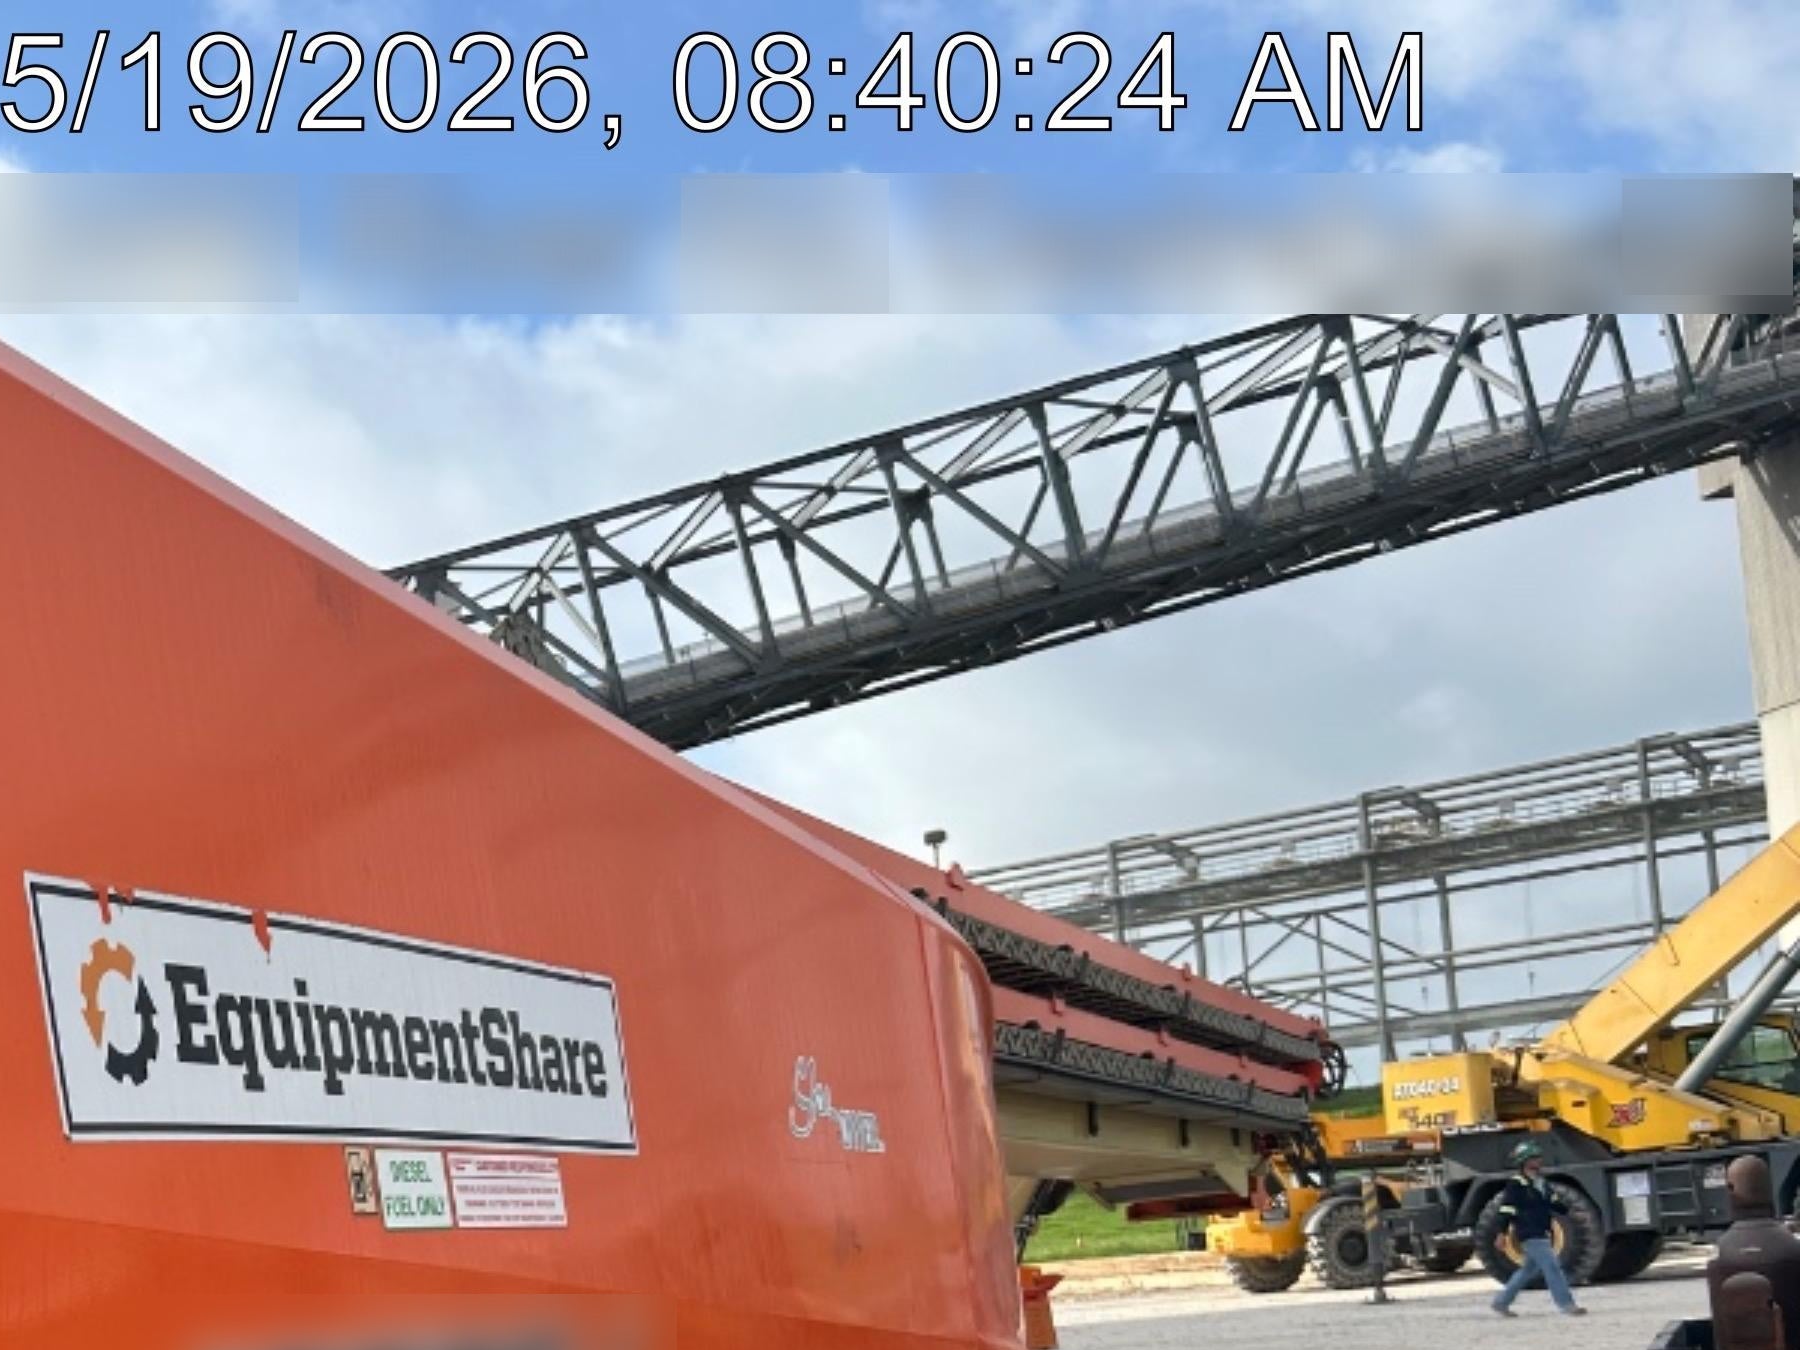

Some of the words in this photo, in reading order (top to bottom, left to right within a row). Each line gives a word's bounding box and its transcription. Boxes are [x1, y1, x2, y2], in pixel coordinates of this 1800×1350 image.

[164, 962, 608, 1098] EquipmentShare
[389, 1160, 432, 1183] DIESEL
[385, 1196, 416, 1217] FUEL
